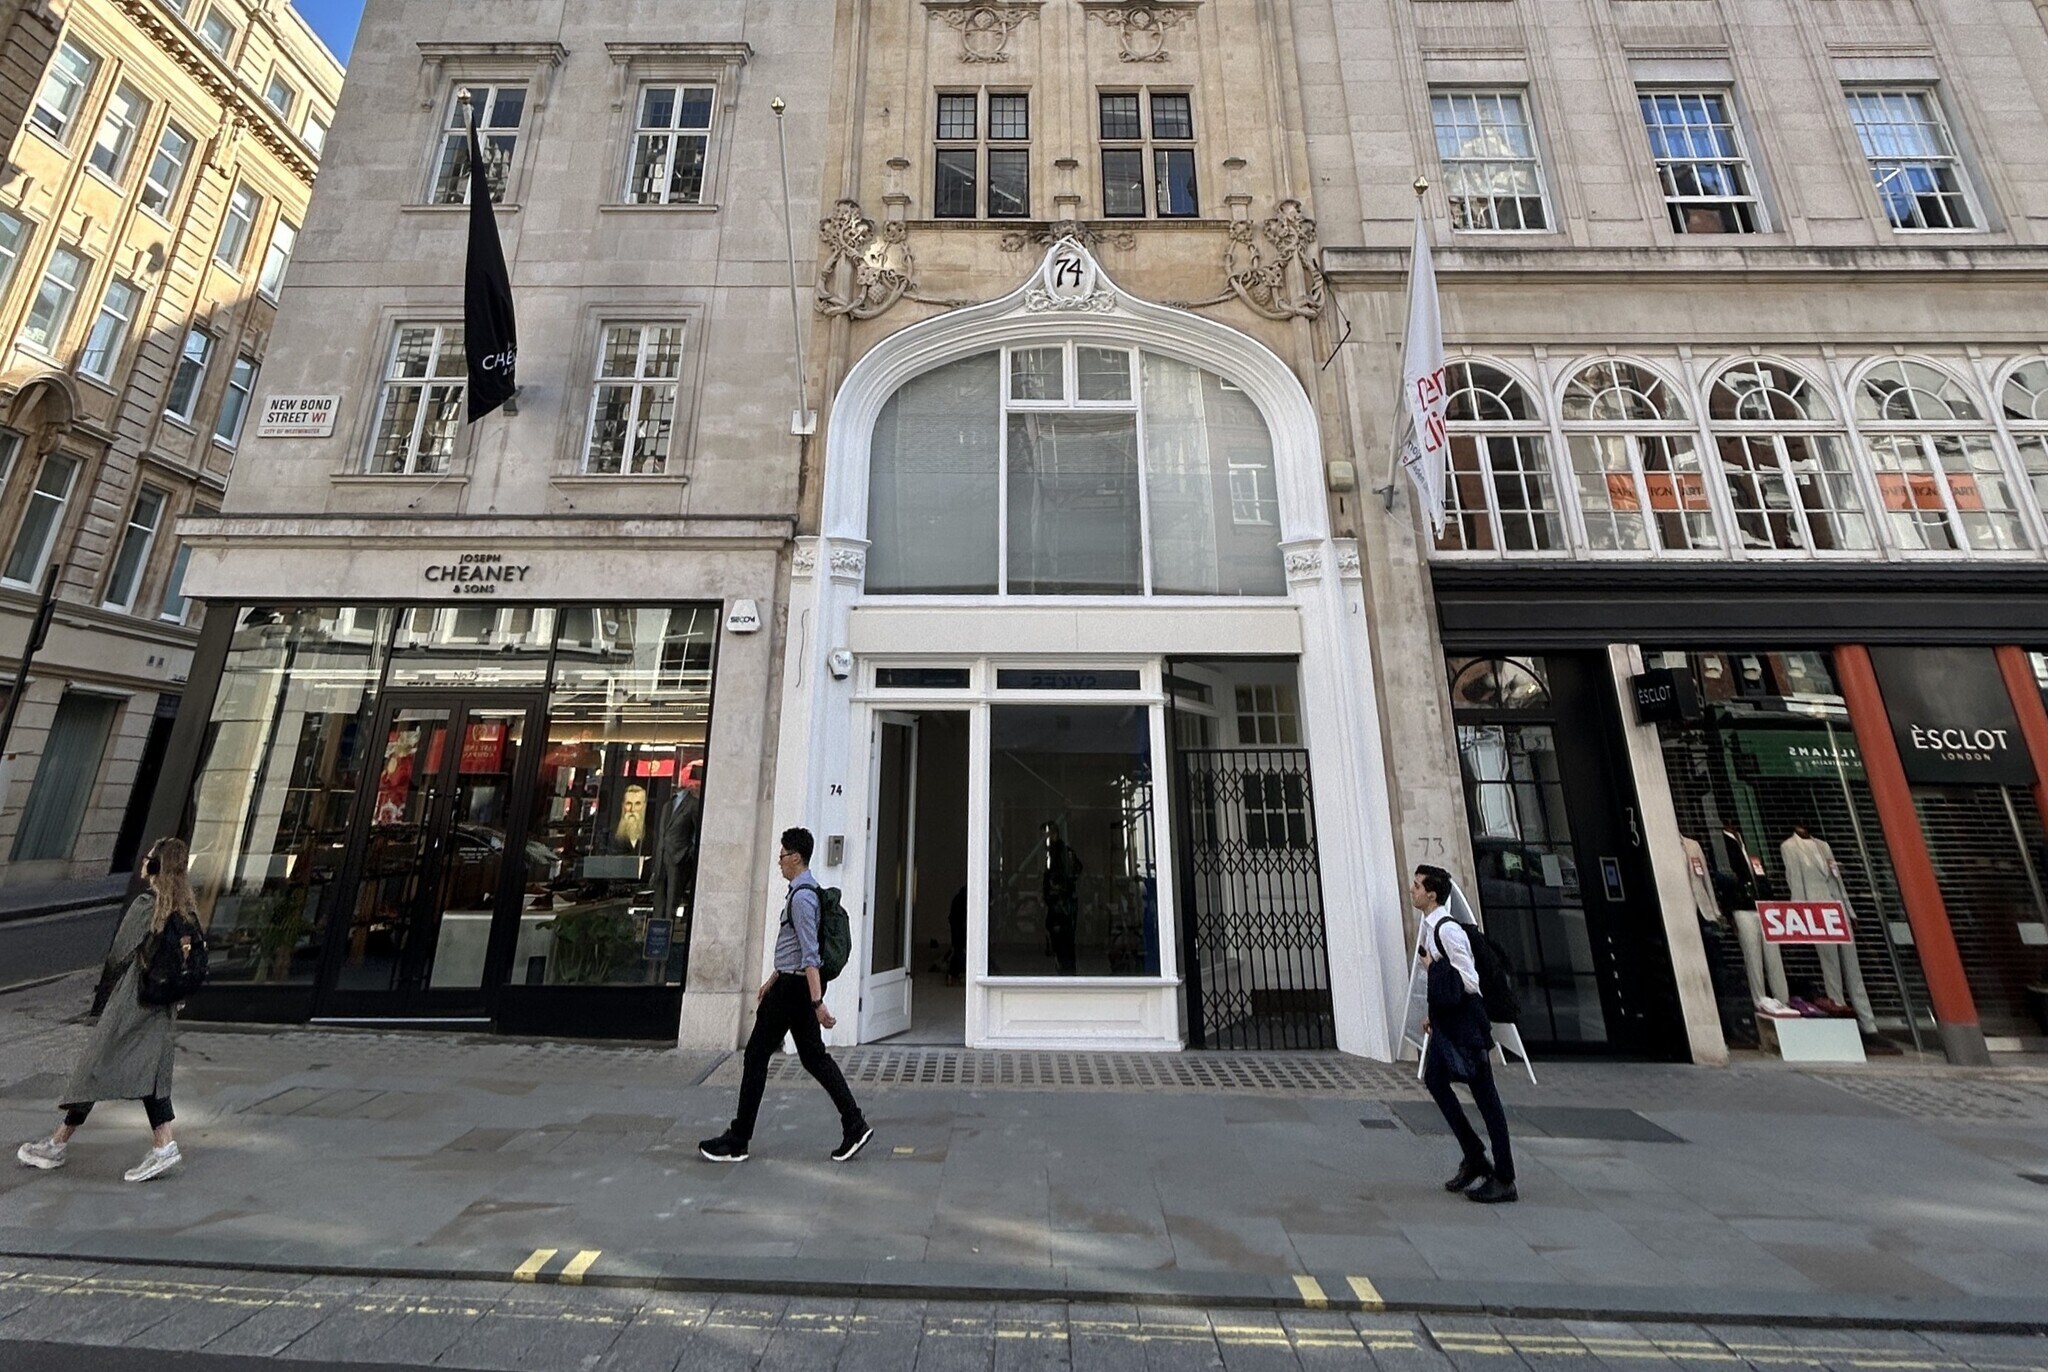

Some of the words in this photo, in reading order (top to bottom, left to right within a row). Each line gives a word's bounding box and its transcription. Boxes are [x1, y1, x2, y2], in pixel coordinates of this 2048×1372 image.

[1055, 257, 1084, 288] 74
[270, 399, 298, 410] NEW
[300, 399, 332, 410] BOND
[267, 411, 309, 423] STREET
[311, 411, 327, 423] W1
[458, 553, 502, 565] JOSEPH
[424, 564, 530, 582] CHEANEY
[452, 584, 460, 594] &
[463, 584, 496, 594] SONS
[1910, 723, 2008, 750] ÈSCLOT
[1940, 752, 1991, 761] LONDON
[830, 784, 843, 796] 74
[1418, 837, 1445, 857] 73
[1764, 908, 1846, 936] SALE
